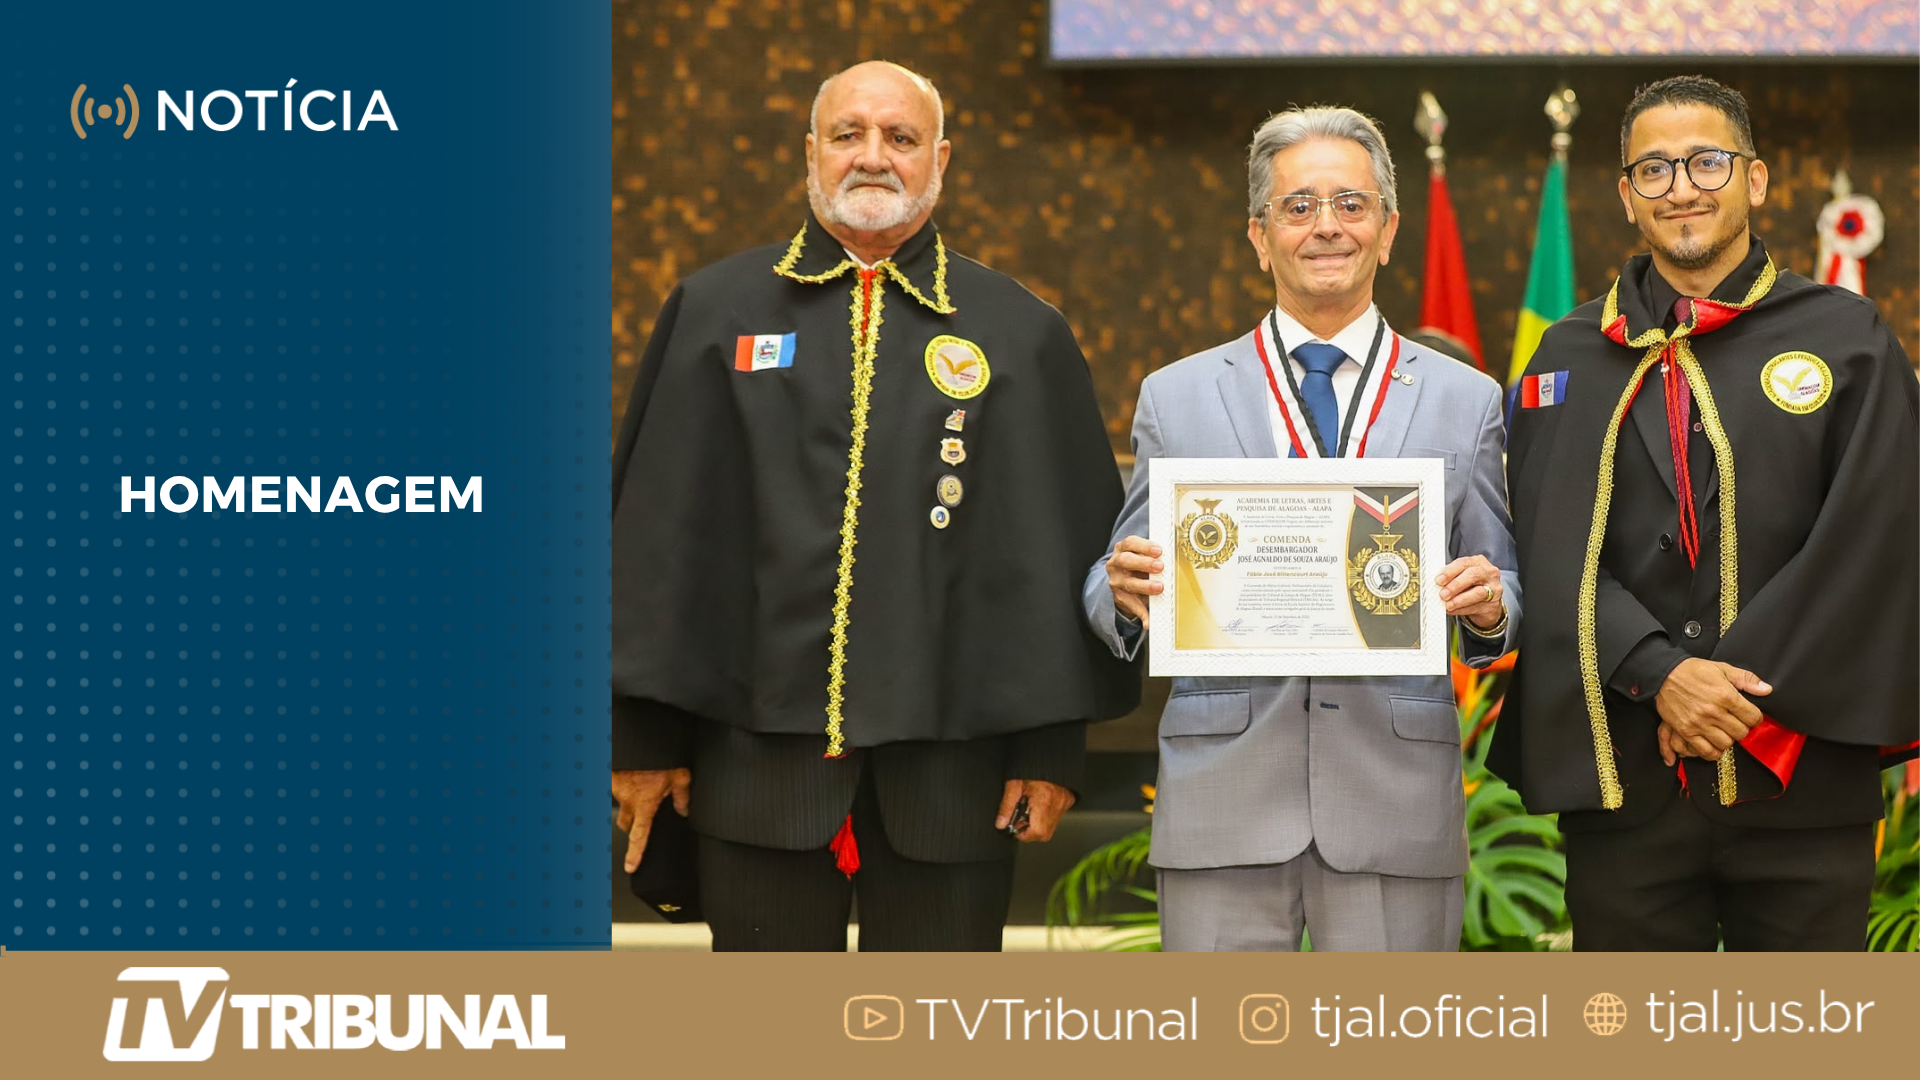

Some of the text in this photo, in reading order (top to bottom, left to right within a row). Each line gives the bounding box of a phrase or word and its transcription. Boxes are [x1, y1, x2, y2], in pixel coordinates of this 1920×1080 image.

[1263, 535, 1311, 543] COMENDA
[1237, 554, 1252, 564] JOSÉ
[1314, 554, 1338, 564] ARAÚJO
